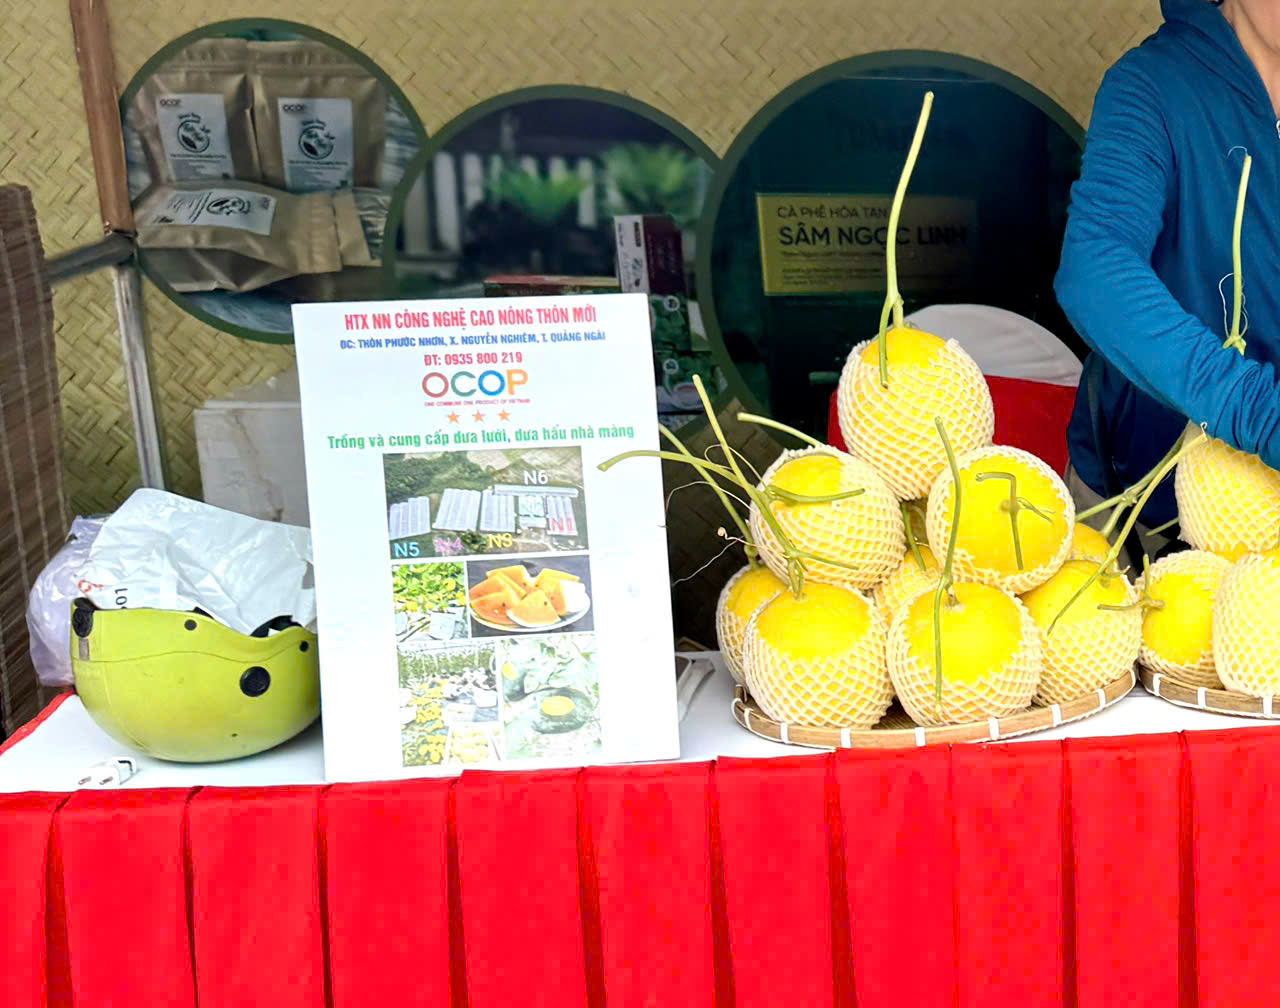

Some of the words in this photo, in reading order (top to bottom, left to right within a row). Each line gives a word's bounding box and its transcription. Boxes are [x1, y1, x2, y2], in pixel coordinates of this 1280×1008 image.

[778, 222, 830, 246] SÂM
[917, 225, 969, 244] LINH
[344, 313, 370, 331] HTX
[372, 313, 392, 330] NN
[470, 310, 495, 327] CAO
[424, 353, 442, 367] ĐT:
[444, 353, 474, 366] 0935
[476, 352, 498, 365] 800
[501, 351, 523, 364] 219
[422, 369, 529, 399] OCOP
[368, 433, 385, 448] và
[388, 434, 421, 448] cung
[523, 470, 549, 485] N6
[393, 542, 420, 558] N5
